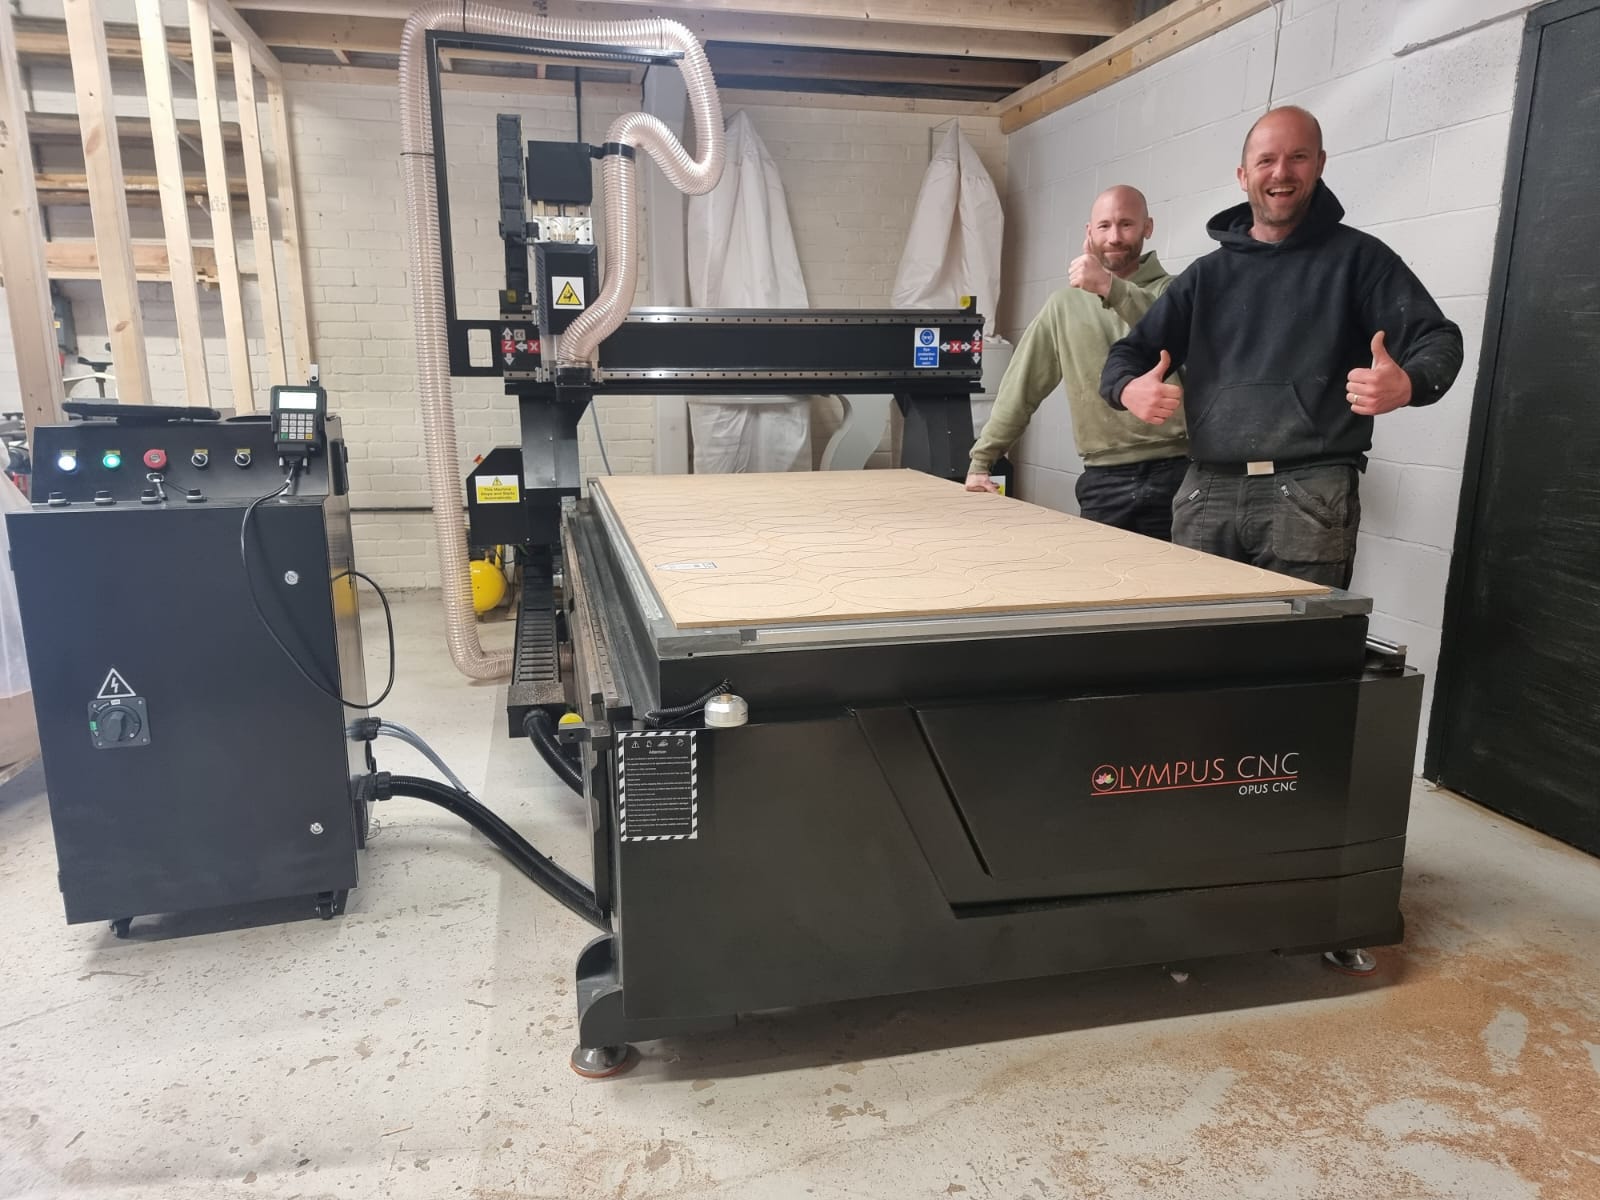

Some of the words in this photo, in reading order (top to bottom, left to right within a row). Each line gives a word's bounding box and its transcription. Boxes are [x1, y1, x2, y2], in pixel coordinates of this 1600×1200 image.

[504, 341, 513, 350] Z
[529, 342, 539, 352] X
[952, 343, 959, 351] X
[975, 341, 981, 349] Z
[1091, 758, 1225, 792] OLYMPUS
[1237, 752, 1300, 779] CNC
[1238, 784, 1269, 796] OPUS
[1272, 781, 1298, 793] CNC
